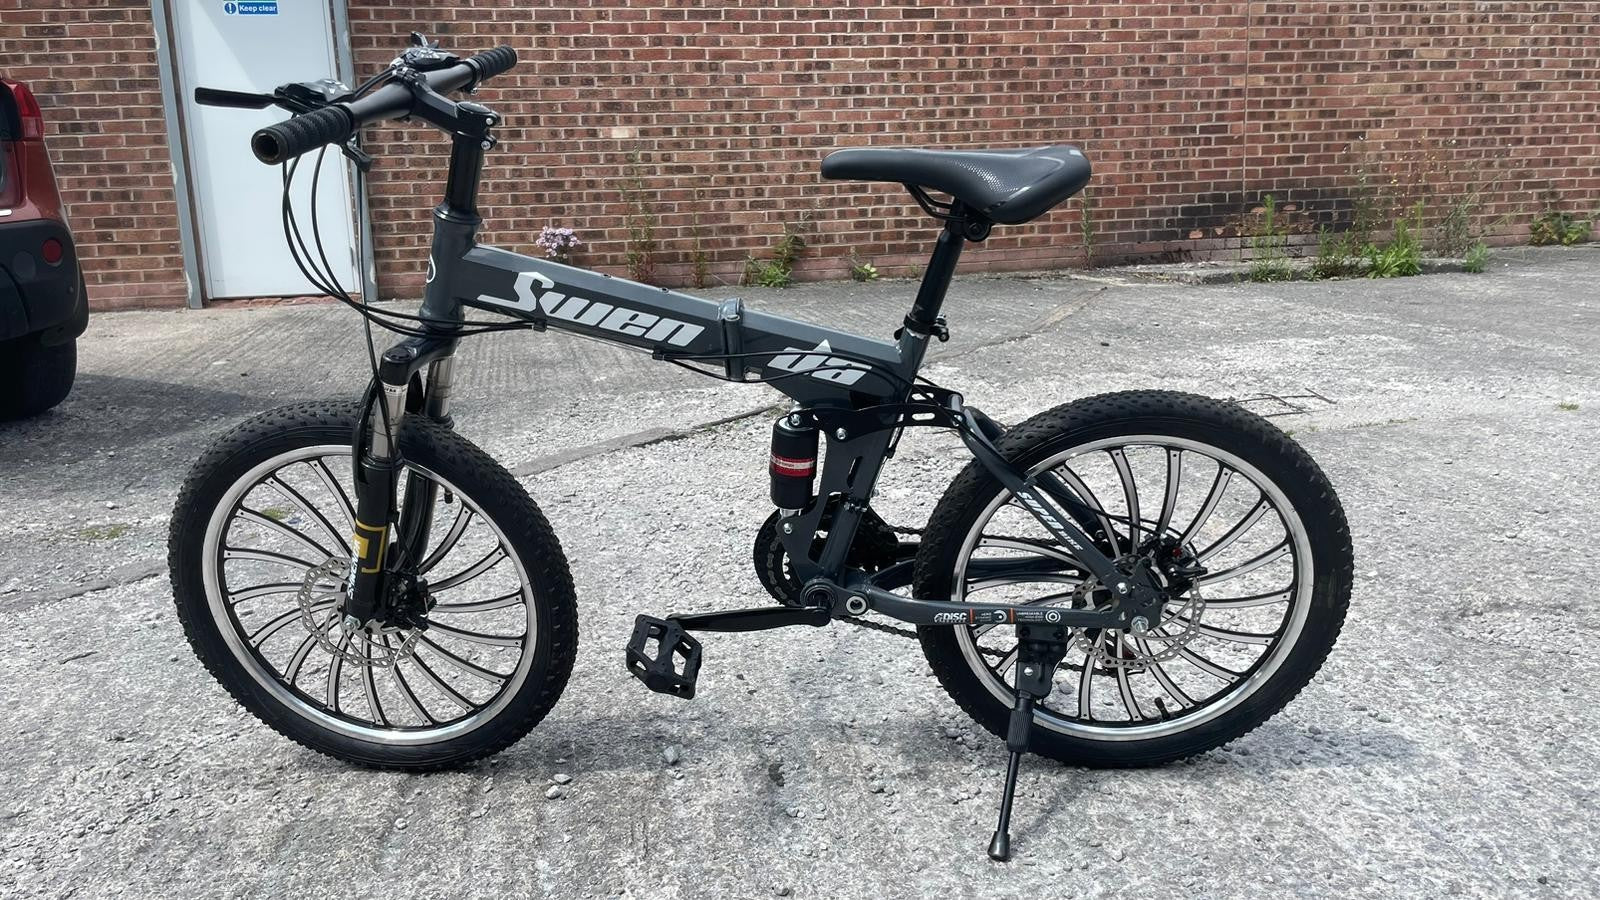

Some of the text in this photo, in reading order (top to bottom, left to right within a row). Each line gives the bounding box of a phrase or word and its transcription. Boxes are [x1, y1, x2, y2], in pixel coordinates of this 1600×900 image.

[239, 5, 258, 13] Keep
[476, 271, 706, 347] Swen
[1016, 491, 1065, 530] SUPER
